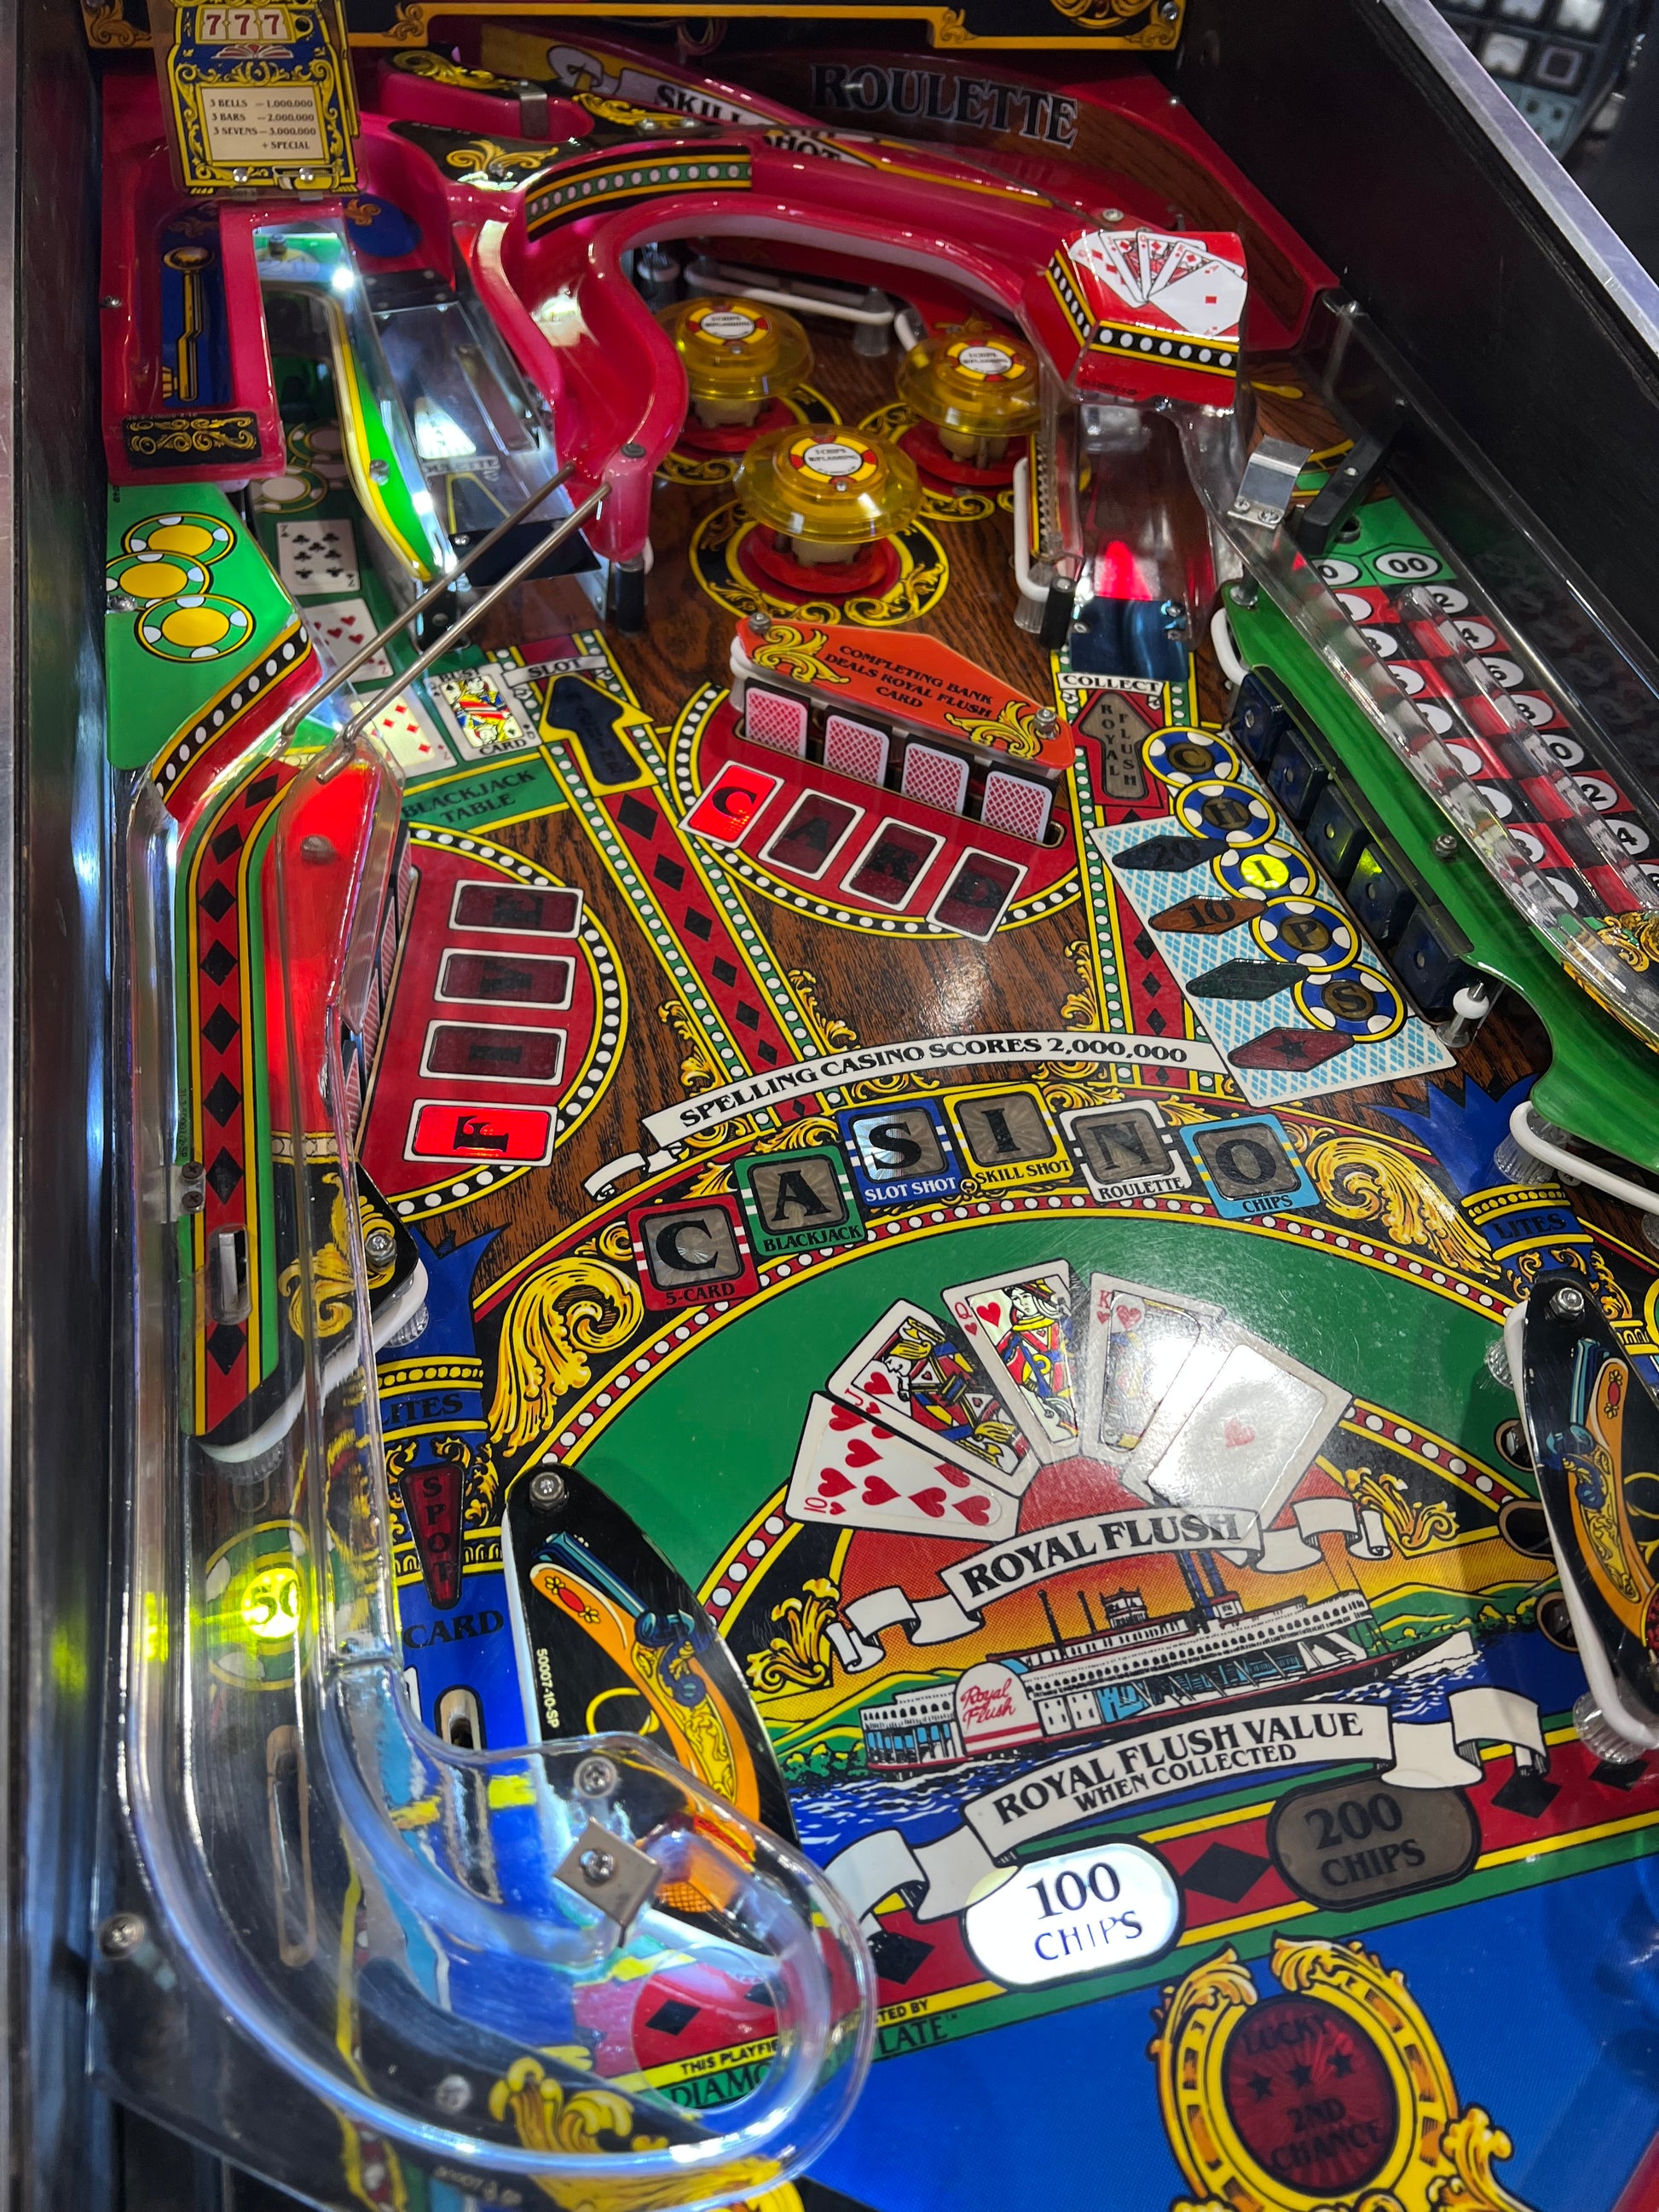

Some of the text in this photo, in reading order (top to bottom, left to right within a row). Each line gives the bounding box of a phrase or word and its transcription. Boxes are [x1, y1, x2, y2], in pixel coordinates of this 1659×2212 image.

[206, 14, 280, 35] 7 7 7
[218, 99, 247, 107] BELLS
[220, 113, 246, 121] BARS
[810, 62, 1080, 149] ROULETTE
[222, 127, 257, 136] SEVENS
[271, 141, 309, 150] SPECIAL
[1388, 557, 1428, 574] 00
[527, 659, 583, 679] SLOT
[824, 652, 994, 719] DEALS ROYAL FLUSH
[839, 645, 994, 706] COMPLETING BANK
[1062, 673, 1161, 694] COLLECT
[876, 685, 924, 709] CARD
[479, 737, 527, 756] CARD
[1101, 703, 1120, 777] ROYAL
[1119, 713, 1138, 787] FLUSH
[402, 769, 537, 821] BLACKJACK
[440, 792, 517, 825] TABLE
[1183, 899, 1237, 930] 10
[679, 1037, 1188, 1127] SPELLING CASINO SCORES 2,000,000
[975, 1159, 1071, 1184] SKILL SHOT
[1098, 1177, 1186, 1200] ROULETTE
[864, 1177, 957, 1202] SLOT SHOT
[1242, 1195, 1293, 1213] CHIPS
[762, 1225, 864, 1252] BLACKJACK
[1493, 1212, 1567, 1240] LITES
[665, 1282, 735, 1305] 5-CARD
[959, 1513, 1243, 1598] ROYAL FLUSH
[403, 1609, 505, 1649] CARD
[536, 1647, 560, 1729] 50007-10-SP
[960, 1677, 1014, 1711] Royal
[962, 1701, 1017, 1733] Flush
[991, 1711, 1364, 1826] ROYAL FLUSH VALUE
[1072, 1745, 1298, 1812] WHEN COLLECTED
[1304, 1793, 1402, 1851] 200
[1321, 1839, 1426, 1887] CHIPS
[1026, 1862, 1121, 1920] 100
[1034, 1910, 1143, 1961] CHIPS
[679, 2056, 716, 2075] THIS
[910, 1999, 928, 2013] BY
[1242, 2013, 1331, 2055] LUCKY
[1286, 2096, 1347, 2134] 2ND
[1270, 2118, 1384, 2171] CHANCE
